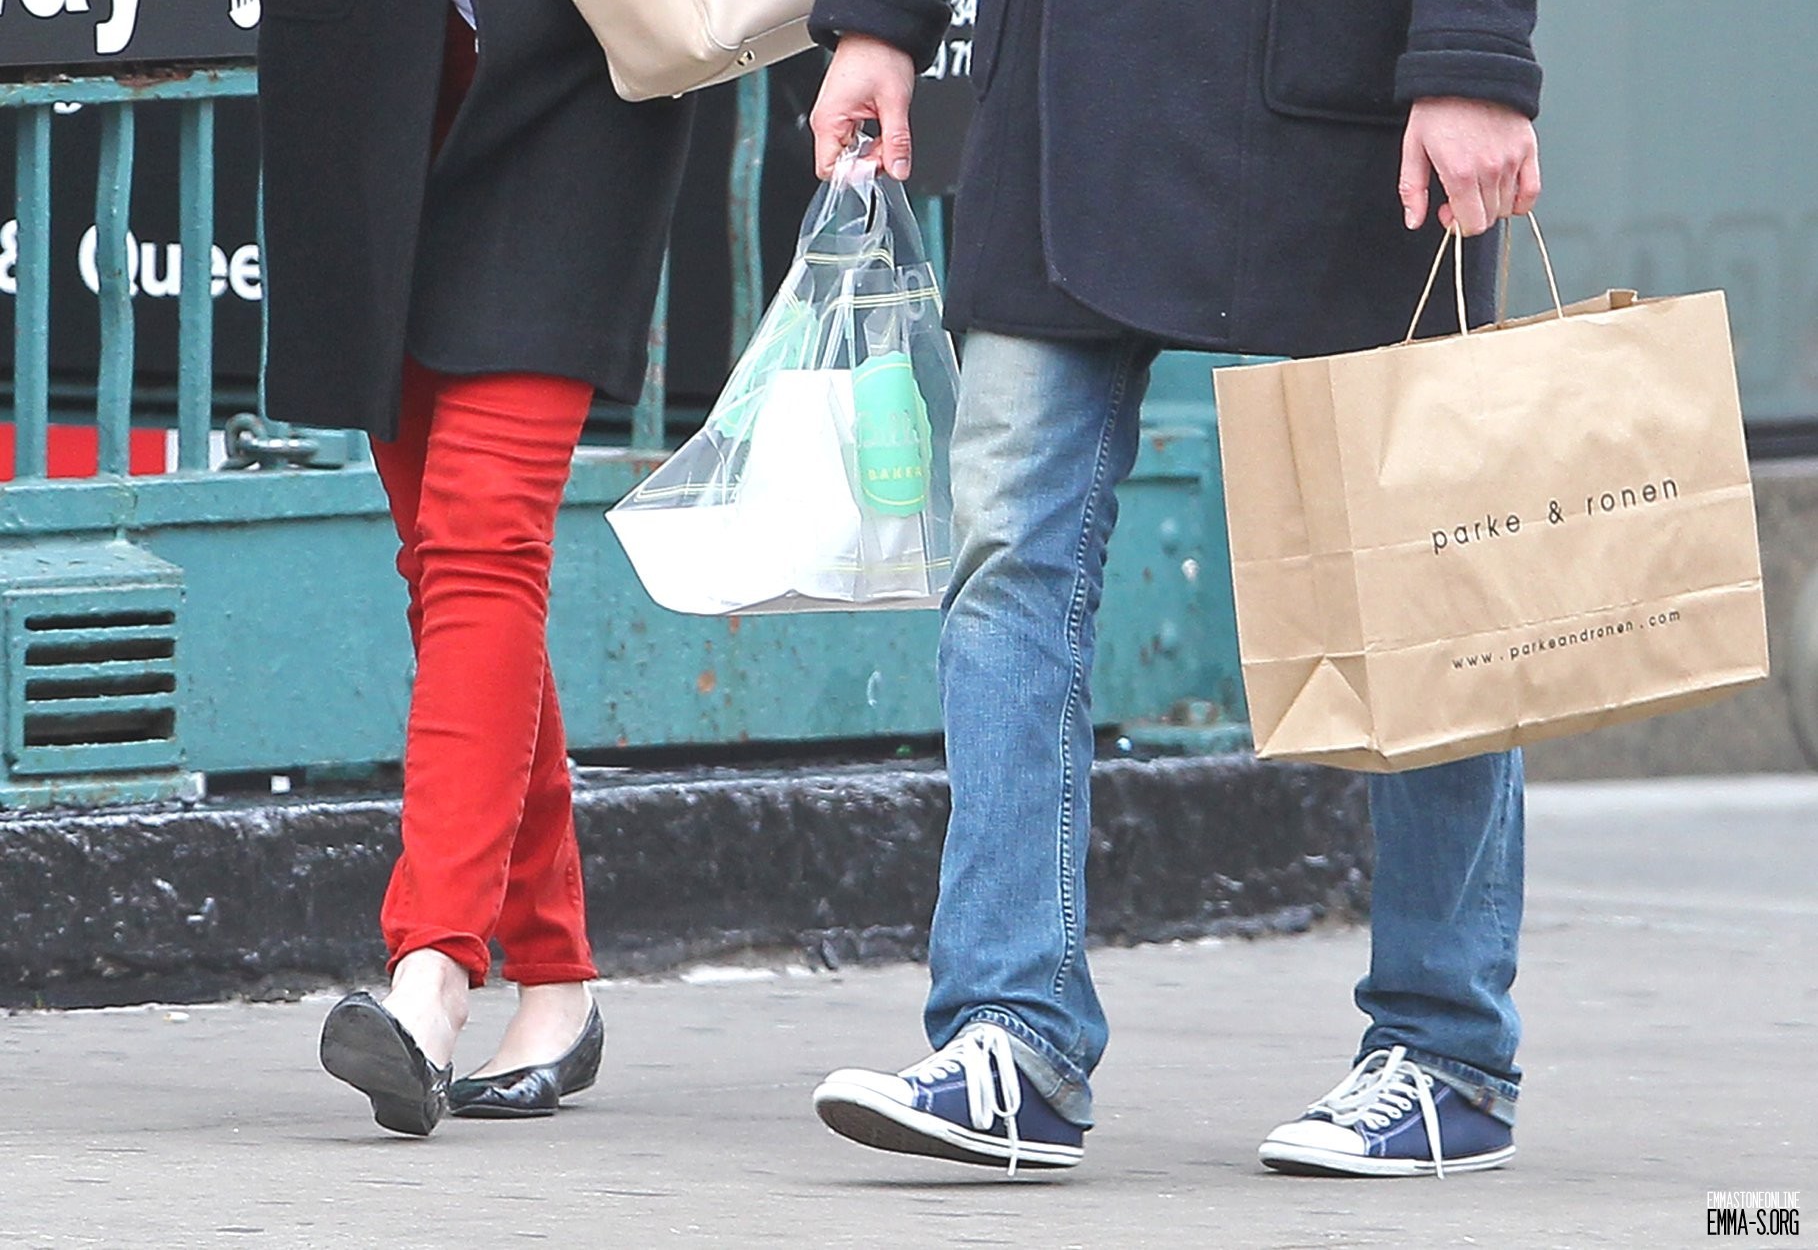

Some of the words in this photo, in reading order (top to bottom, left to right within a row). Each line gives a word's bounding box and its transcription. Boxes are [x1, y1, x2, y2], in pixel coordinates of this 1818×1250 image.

[1431, 513, 1521, 555] parke
[1548, 500, 1565, 525] &
[1586, 478, 1678, 516] ronen
